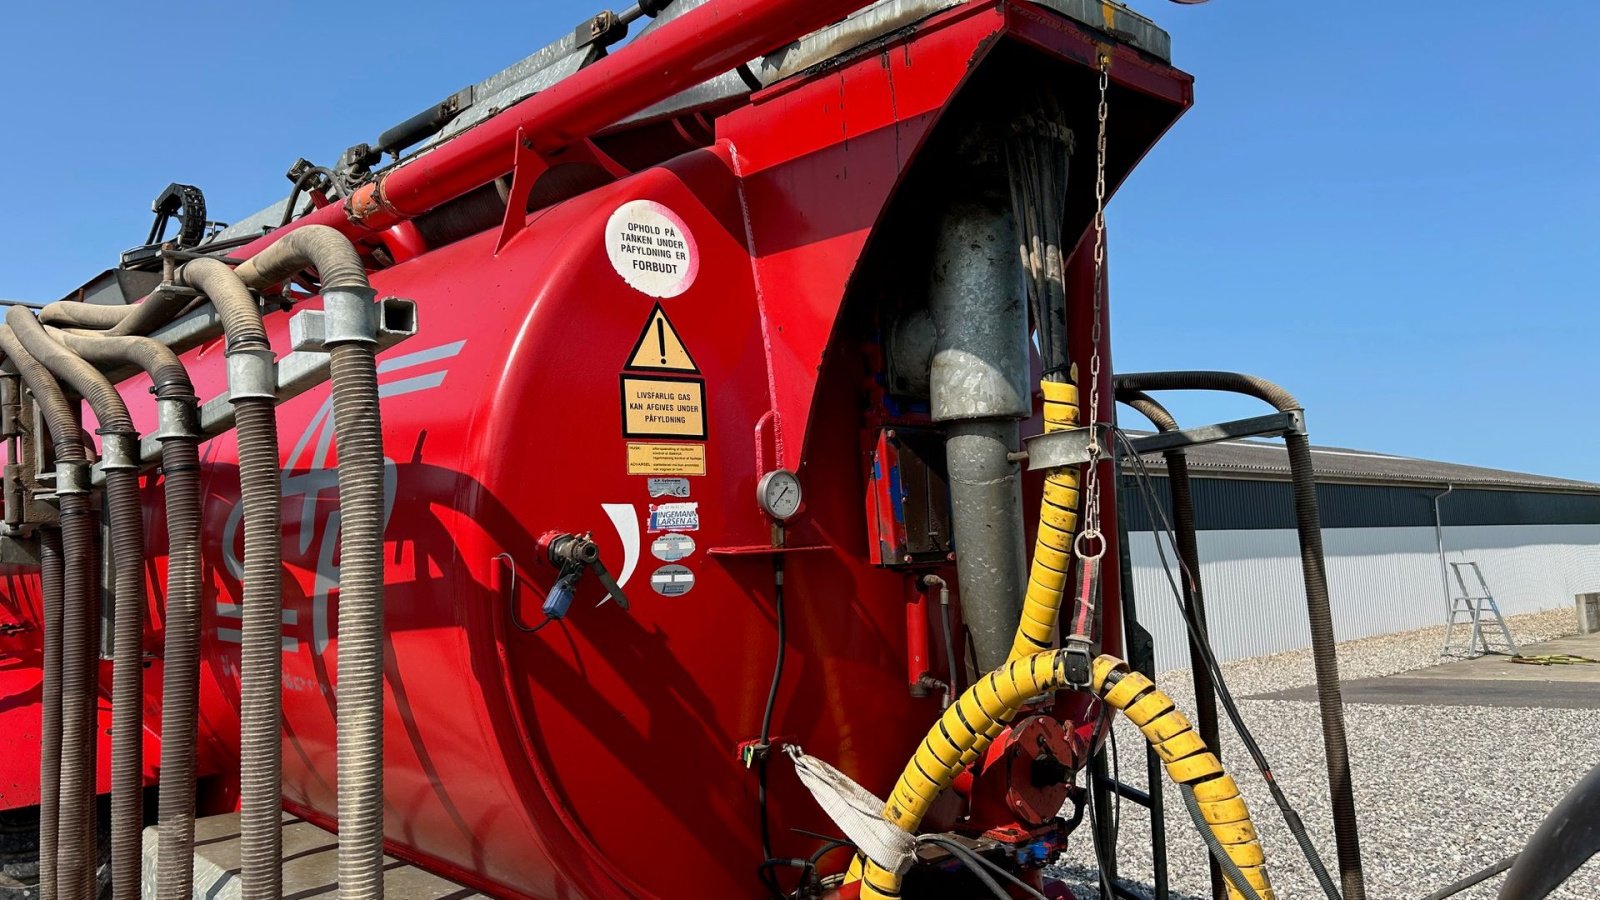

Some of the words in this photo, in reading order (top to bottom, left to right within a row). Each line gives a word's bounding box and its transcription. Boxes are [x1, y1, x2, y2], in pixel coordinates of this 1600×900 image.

[628, 222, 660, 235] OPHOLD
[664, 227, 675, 237] PÅ
[621, 233, 653, 245] TANKEN
[656, 238, 684, 249] UNDER
[621, 244, 671, 259] PÅFYLDNING
[676, 251, 686, 260] ER
[632, 260, 678, 274] FORBUDT
[636, 391, 674, 400] LIVSFARLIG
[678, 393, 691, 401] GAS
[629, 402, 643, 410] KAN
[646, 403, 674, 411] AFGIVES
[645, 414, 686, 424] PÅFYLDNING
[657, 510, 697, 519] INGEMANN
[657, 518, 686, 526] LARSEN
